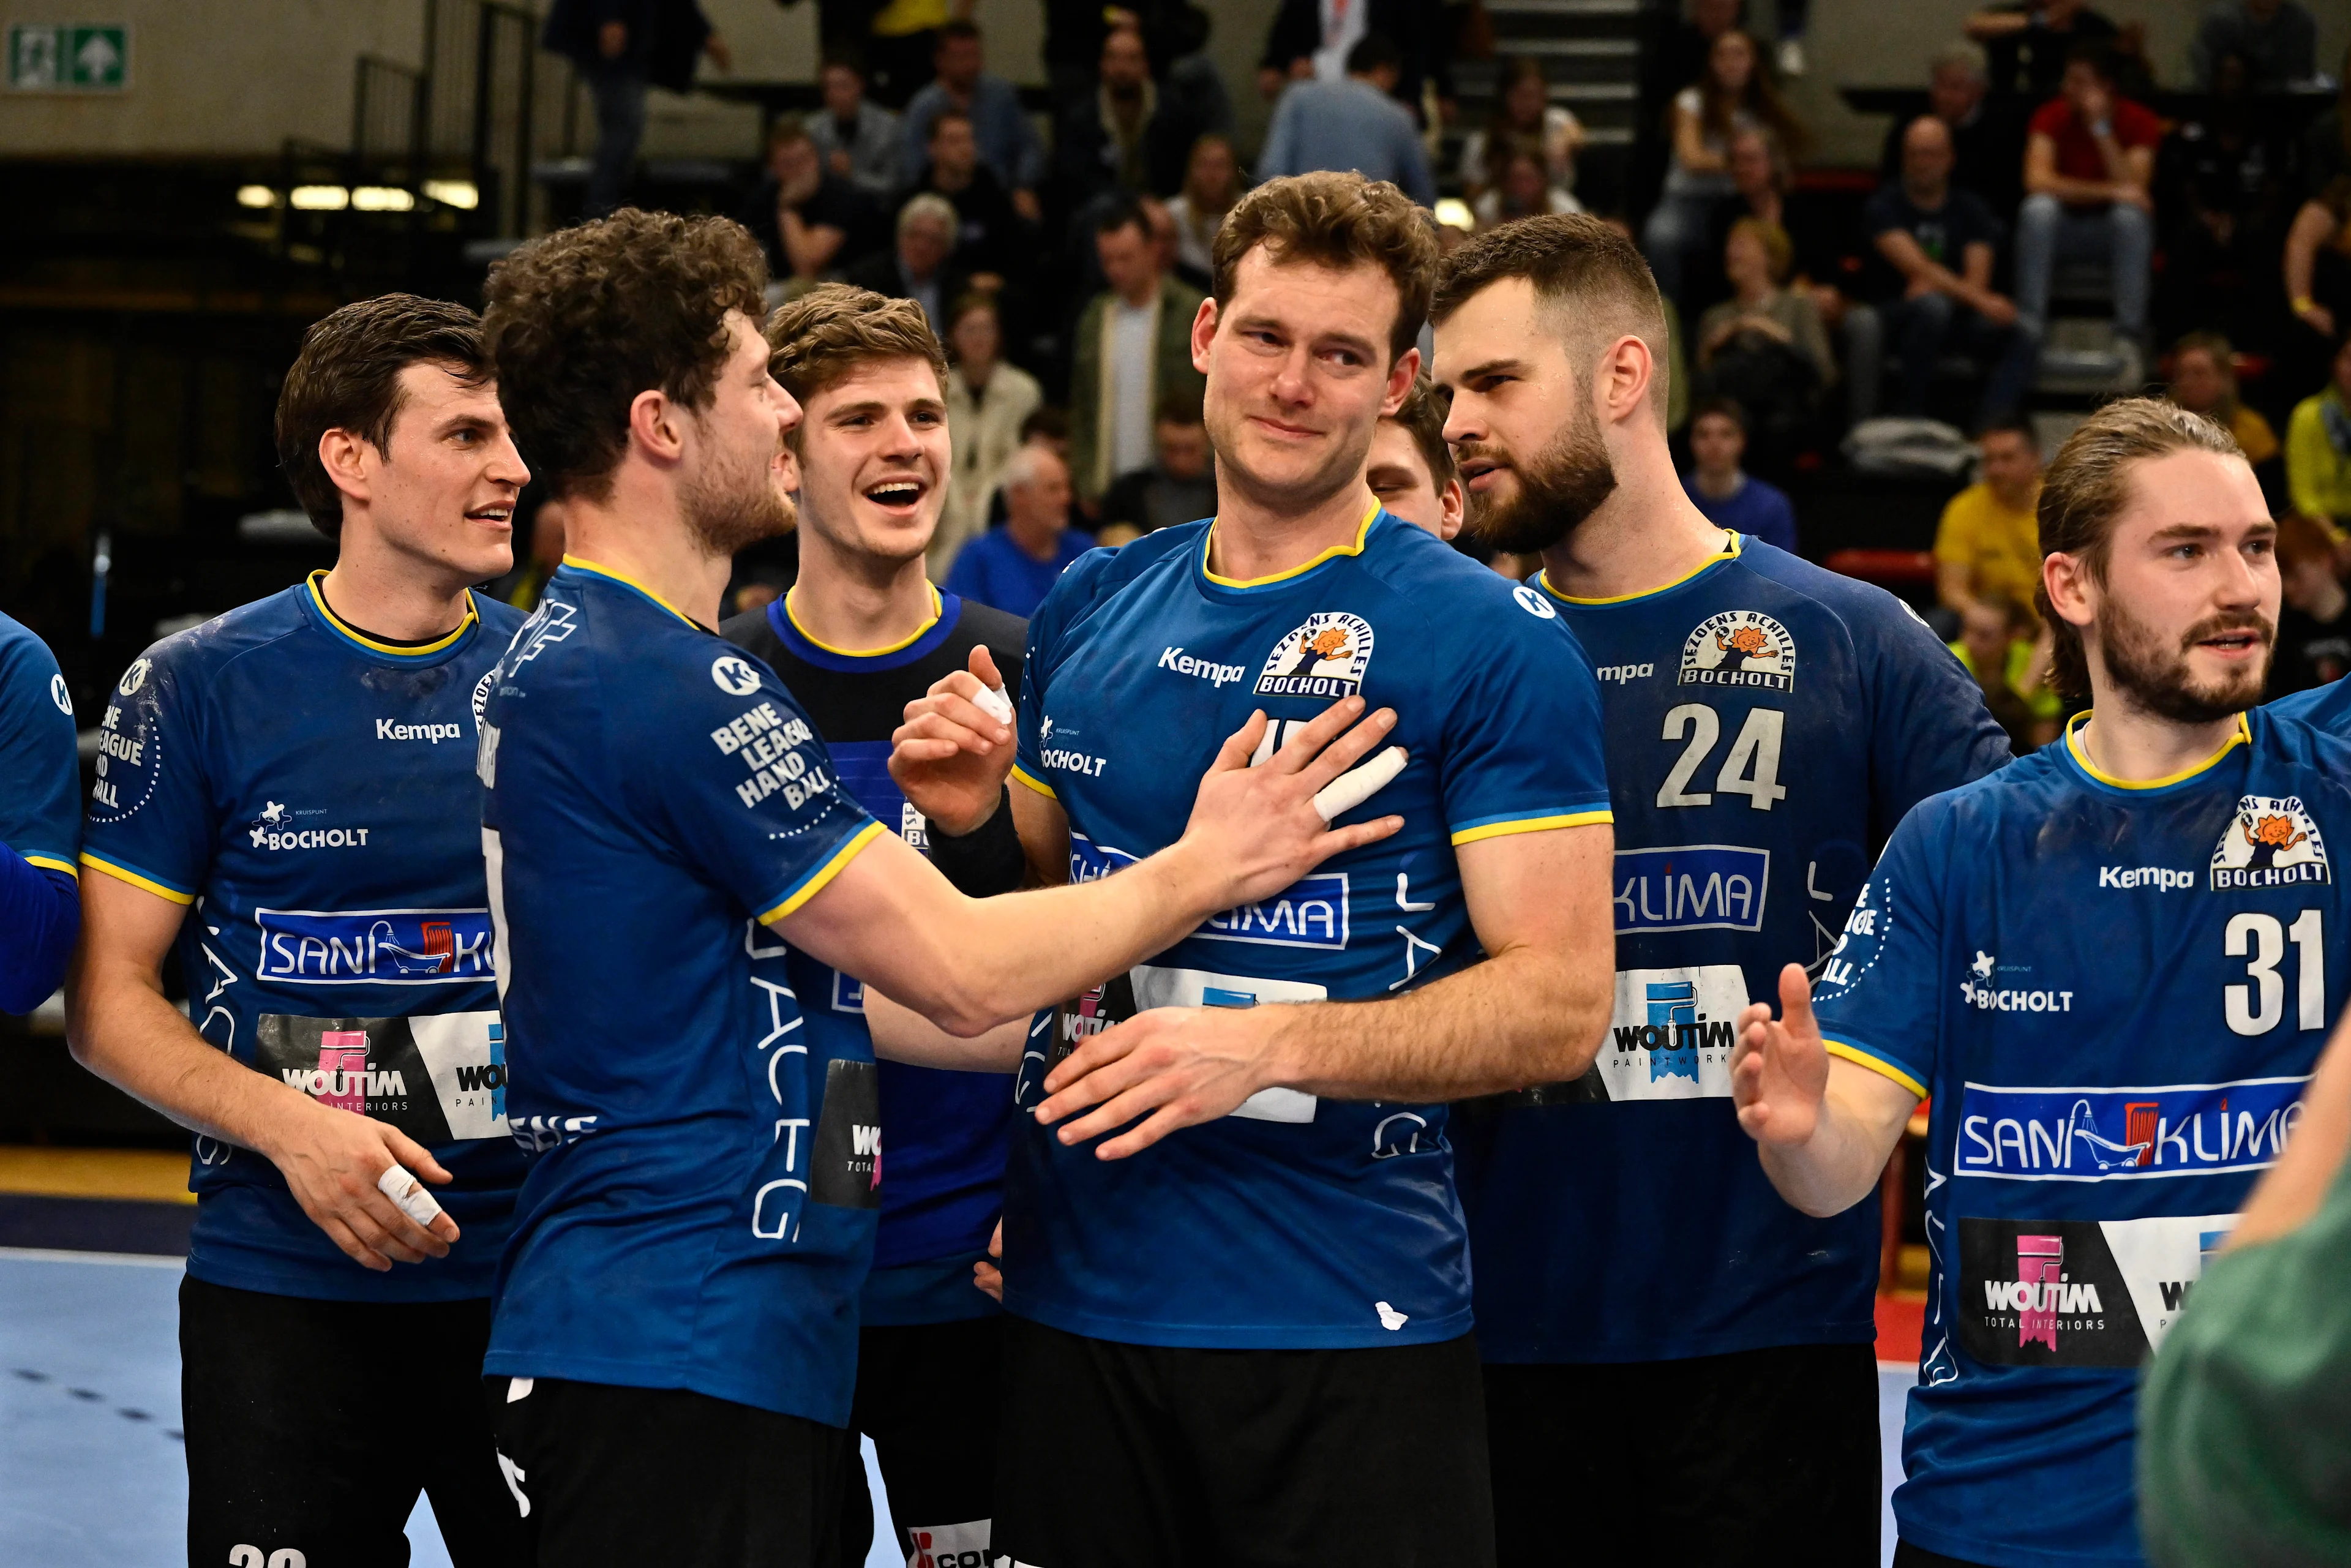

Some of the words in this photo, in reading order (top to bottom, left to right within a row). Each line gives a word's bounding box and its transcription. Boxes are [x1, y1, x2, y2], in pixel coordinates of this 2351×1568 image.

[1337, 615, 1371, 677] ACHILLES
[1685, 612, 1738, 666] SEZOENS
[1746, 613, 1794, 672] ACHILLES
[1158, 647, 1246, 688] Kempa
[1597, 663, 1654, 685] mpa
[1684, 670, 1788, 689] BOCHOLT
[1259, 676, 1355, 699] BOCHOLT
[375, 718, 460, 744] Kempa
[710, 702, 782, 756] BENE
[99, 732, 144, 767] EAGUE
[1657, 703, 1786, 811] 24
[735, 751, 806, 809] HAND
[268, 828, 369, 850] BOCHOLT
[2099, 866, 2194, 892] Kempa
[2216, 863, 2324, 888] BOCHOLT
[271, 932, 376, 975] SANI
[2224, 909, 2325, 1036] 31
[1976, 989, 2074, 1012] BOCHOLT
[1964, 1116, 2075, 1169] SANI
[1984, 1316, 2025, 1329] TOTAL
[2031, 1318, 2105, 1330] INTERIORS
